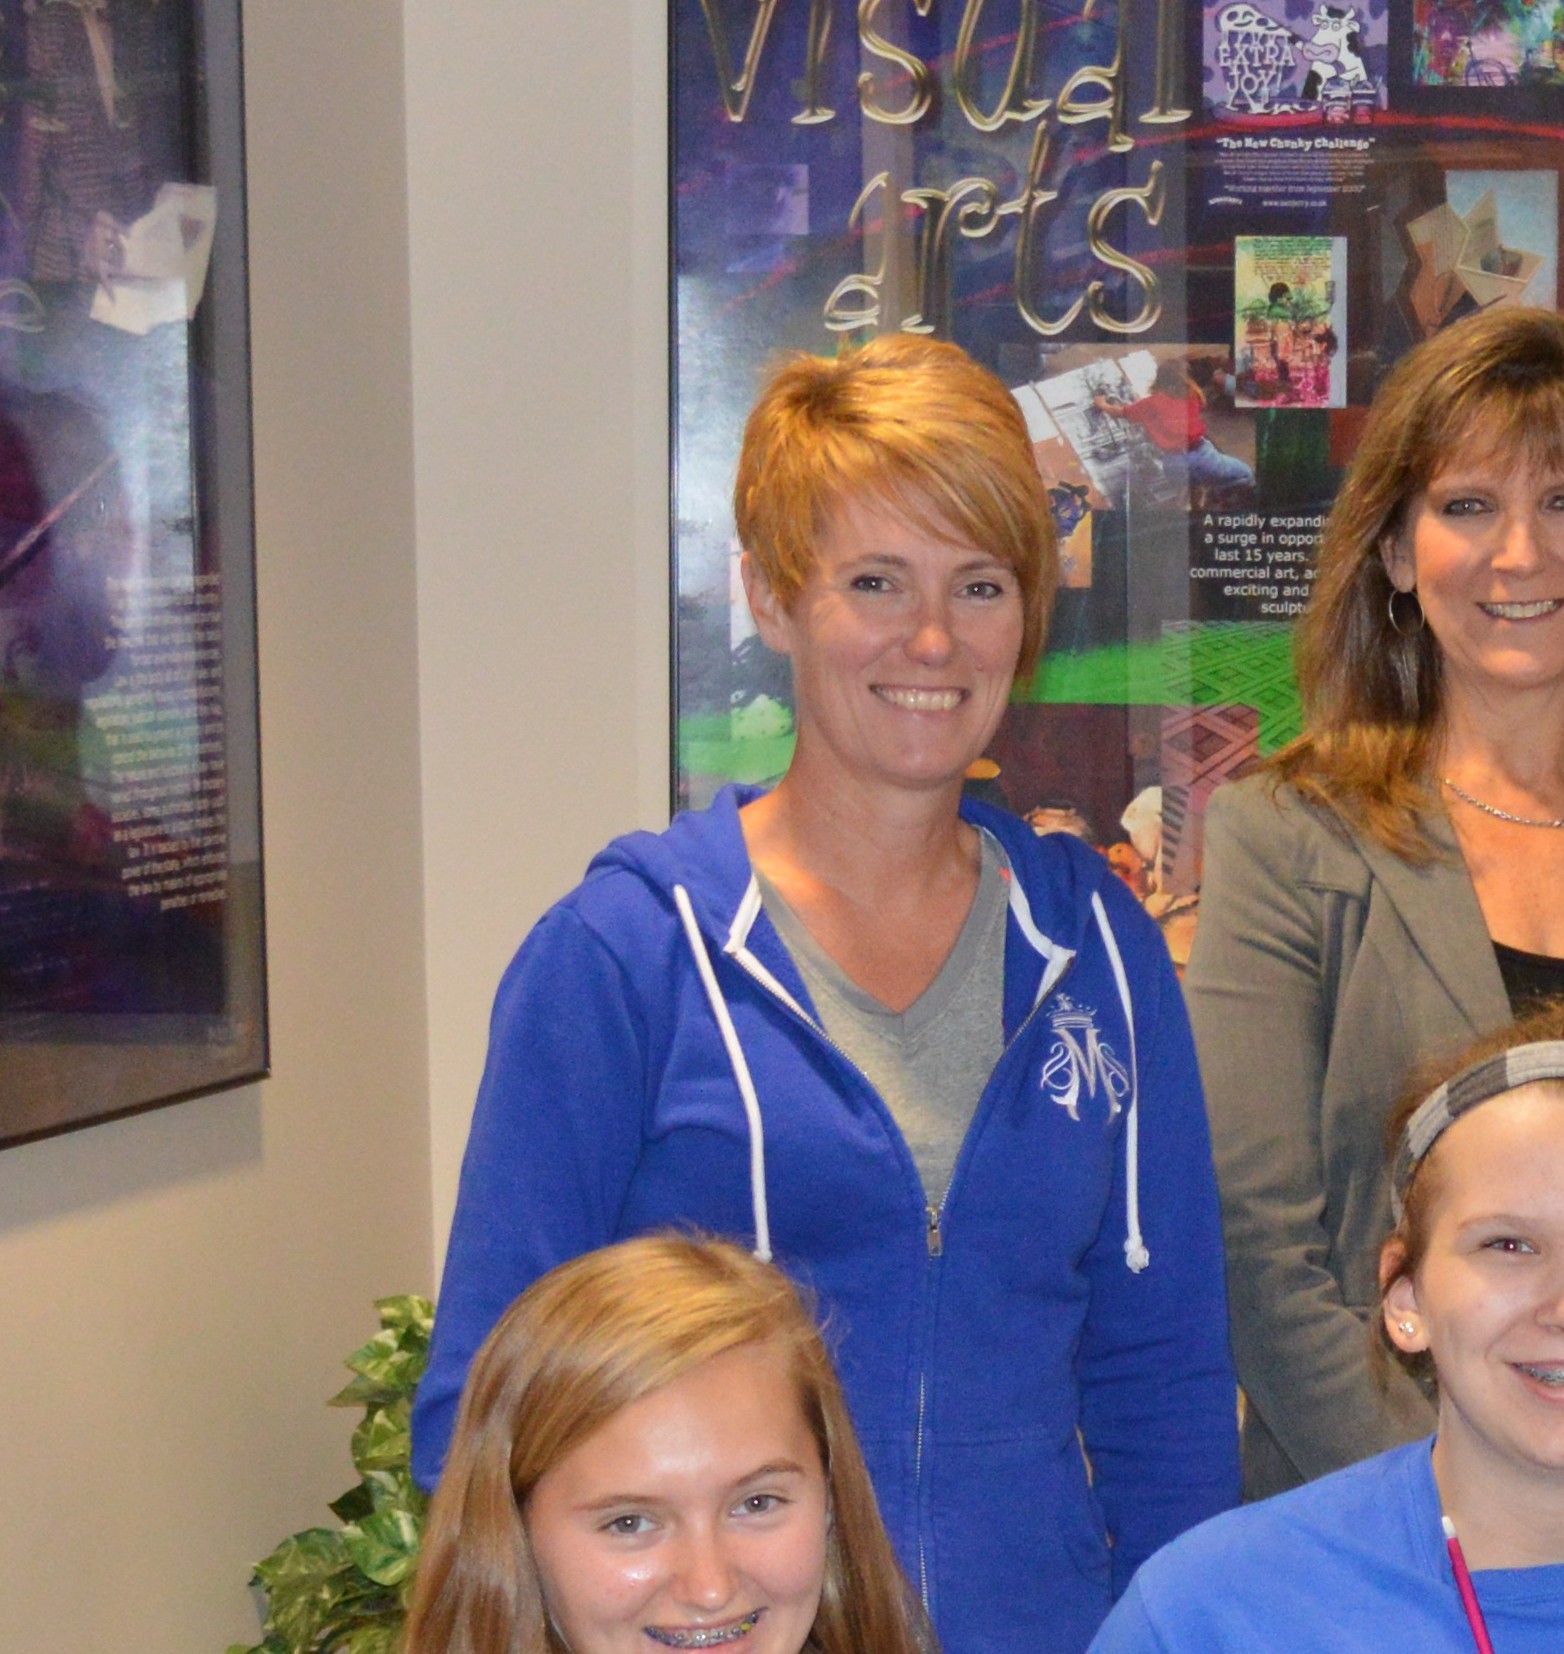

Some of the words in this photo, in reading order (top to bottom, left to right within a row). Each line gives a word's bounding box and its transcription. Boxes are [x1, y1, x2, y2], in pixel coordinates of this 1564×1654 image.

[825, 120, 1166, 336] arts
[1203, 514, 1214, 526] A
[1218, 513, 1266, 529] rapidly
[1204, 533, 1213, 544] a
[1217, 533, 1258, 547] surge
[1261, 532, 1274, 544] in
[1214, 549, 1240, 561] last
[1245, 549, 1262, 561] 15
[1266, 552, 1310, 564] years.
[1190, 566, 1270, 579] commercial
[1274, 567, 1300, 580] art,
[1223, 585, 1279, 599] exciting
[1282, 584, 1310, 596] and
